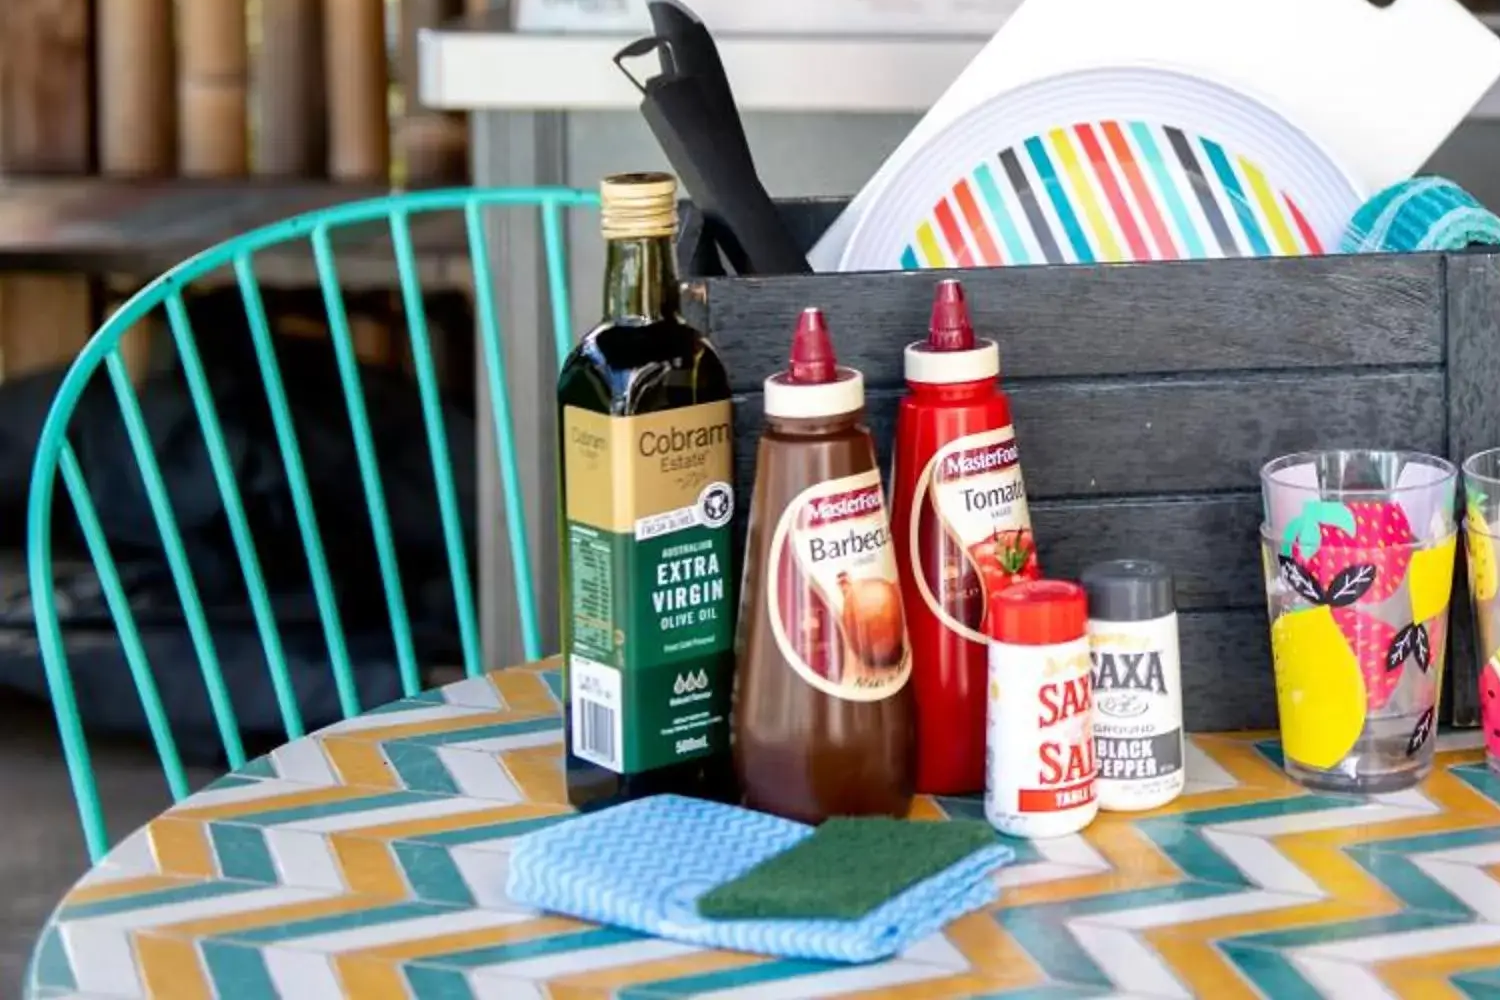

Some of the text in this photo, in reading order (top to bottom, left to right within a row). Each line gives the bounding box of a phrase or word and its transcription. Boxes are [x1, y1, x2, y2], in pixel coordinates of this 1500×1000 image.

[639, 423, 730, 457] Cobram
[657, 553, 720, 586] EXTRA
[652, 578, 723, 613] VIRGIN
[661, 608, 717, 631] OLIVE OIL
[1038, 673, 1093, 728] SAX
[1097, 739, 1153, 758] BLACK
[1095, 758, 1158, 778] PEPPER
